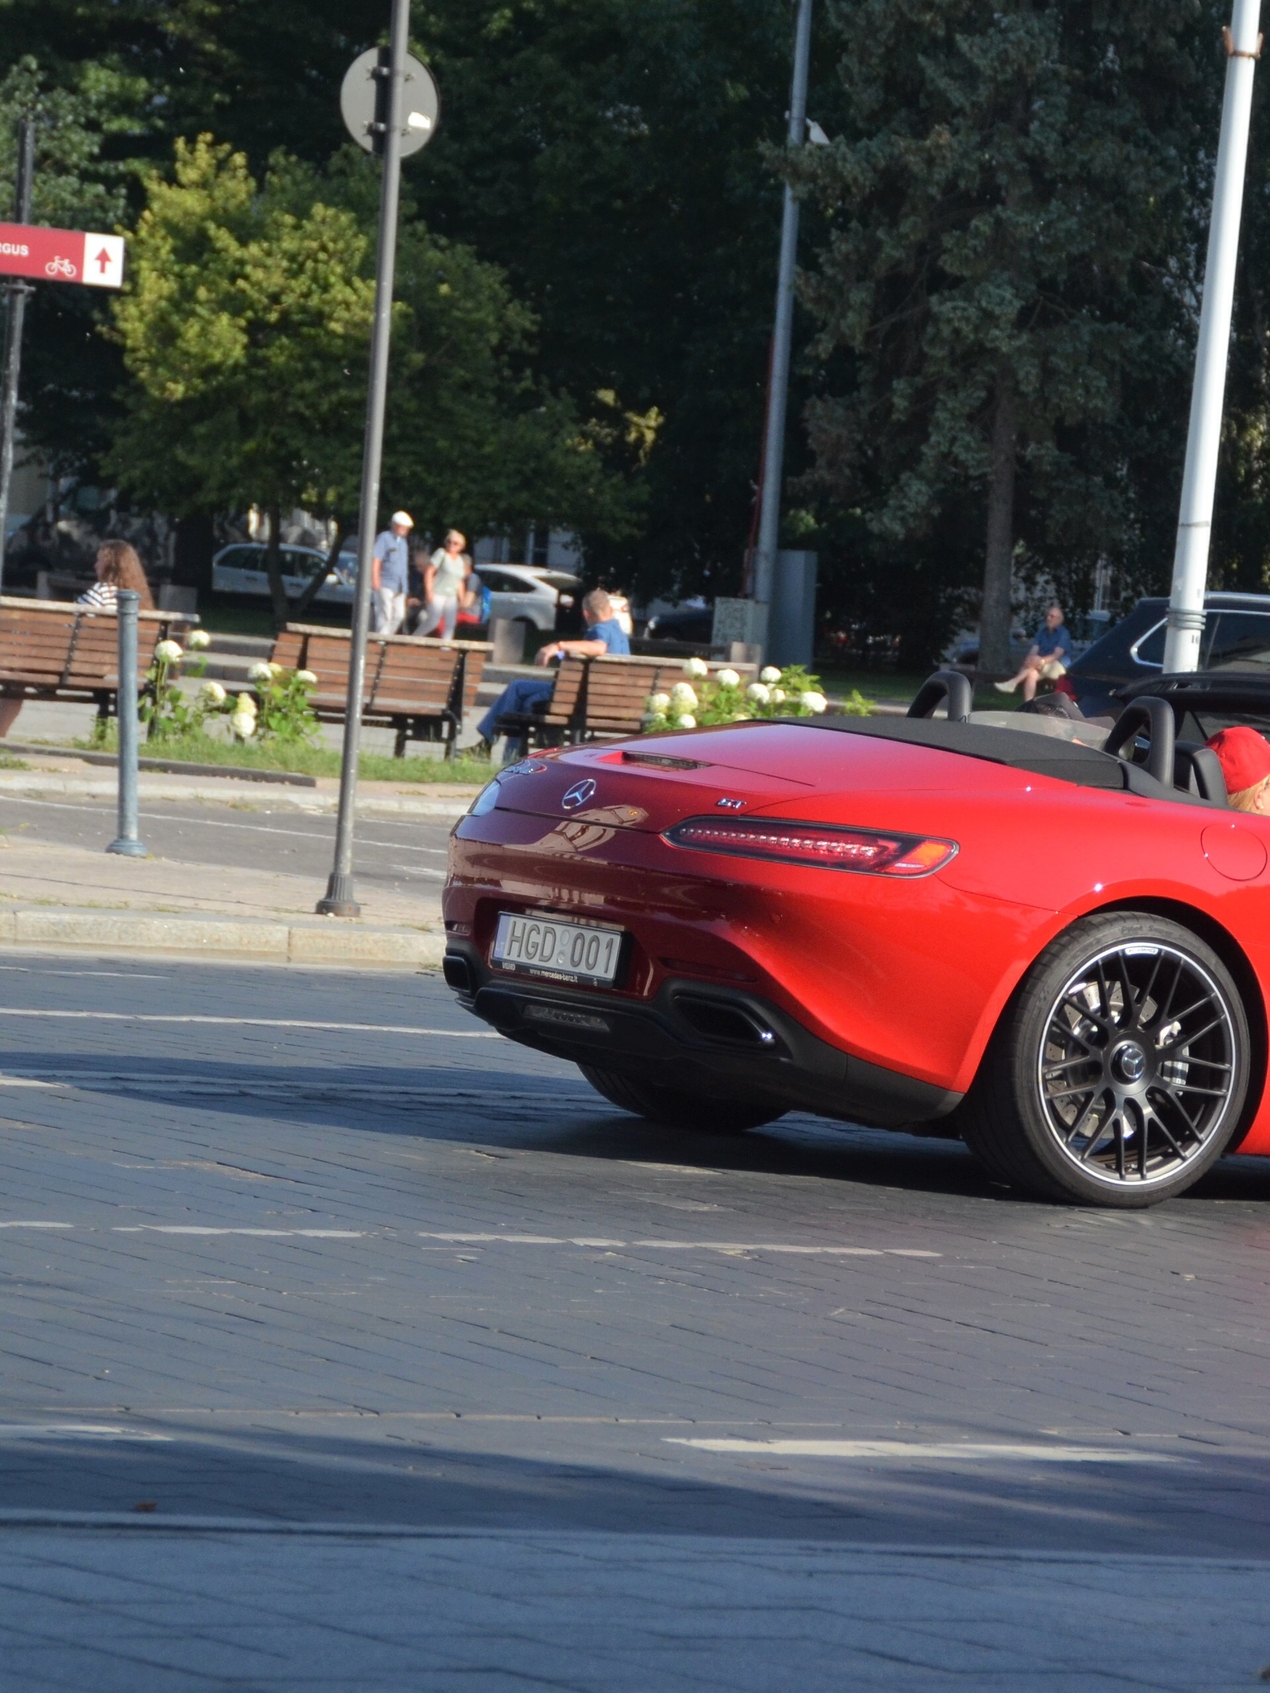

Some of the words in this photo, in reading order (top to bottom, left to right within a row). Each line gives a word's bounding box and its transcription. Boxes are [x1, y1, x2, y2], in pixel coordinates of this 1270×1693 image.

[0, 242, 29, 256] GUS
[507, 921, 556, 962] HGD
[570, 932, 614, 974] 001
